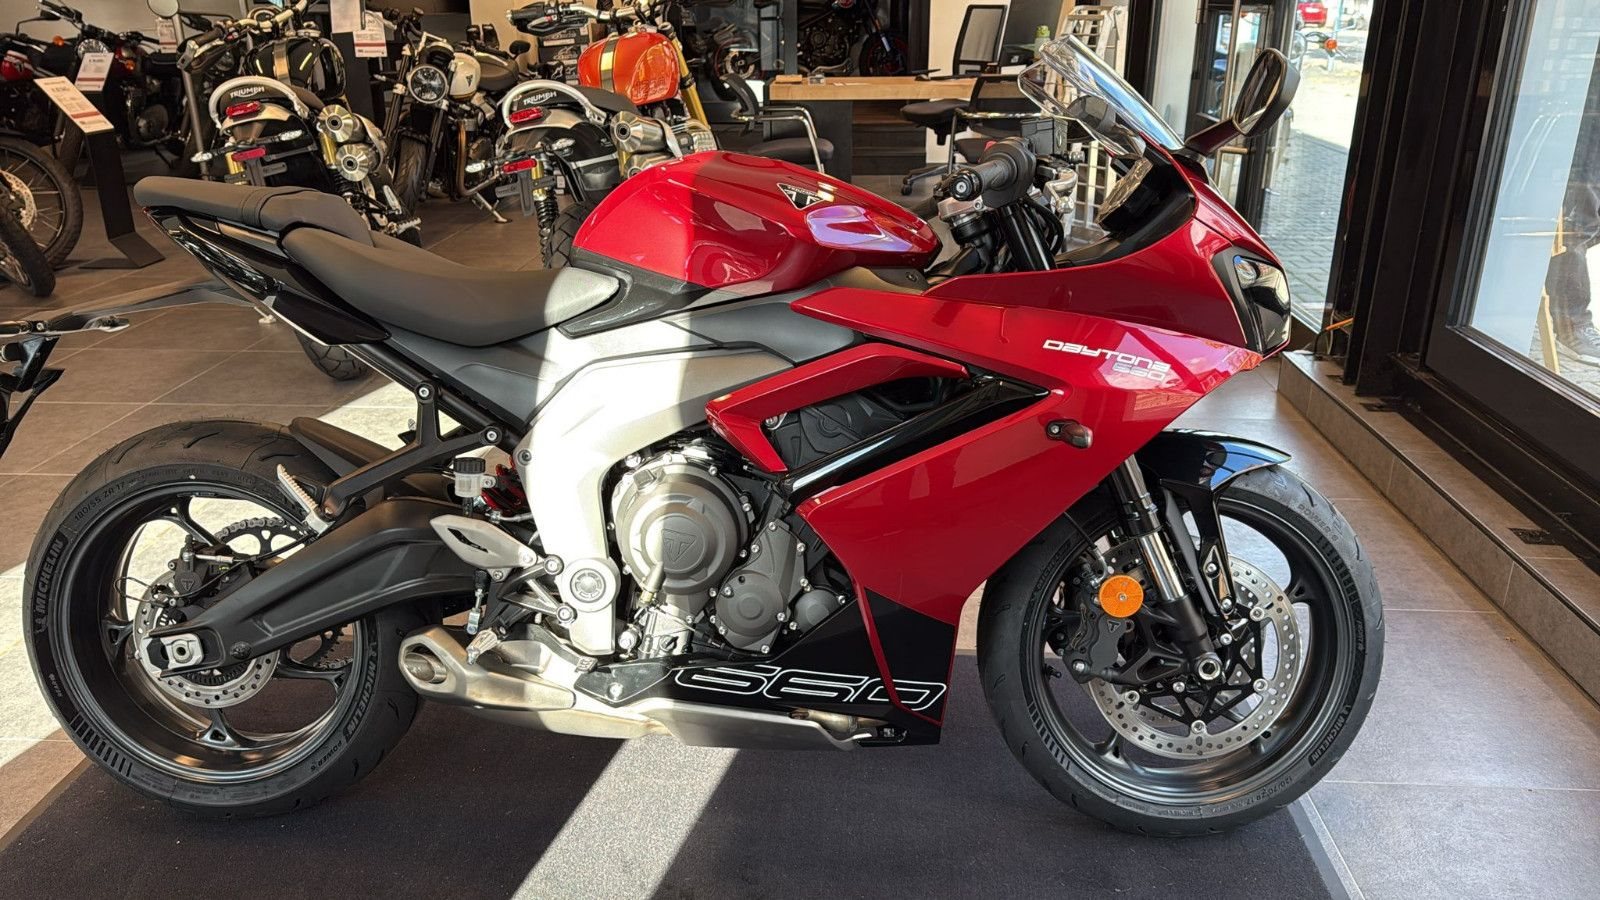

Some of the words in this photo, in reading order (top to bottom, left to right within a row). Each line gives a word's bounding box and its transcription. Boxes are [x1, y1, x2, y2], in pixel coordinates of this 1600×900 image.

[229, 86, 265, 98] TRIUMPH
[523, 91, 557, 105] TRIUMPH
[1112, 362, 1166, 381] 660
[1297, 503, 1331, 534] POWER
[35, 537, 64, 614] MICHELIN
[346, 660, 378, 737] MICHELIN
[674, 664, 947, 711] 660
[1310, 715, 1346, 762] MICHELIN
